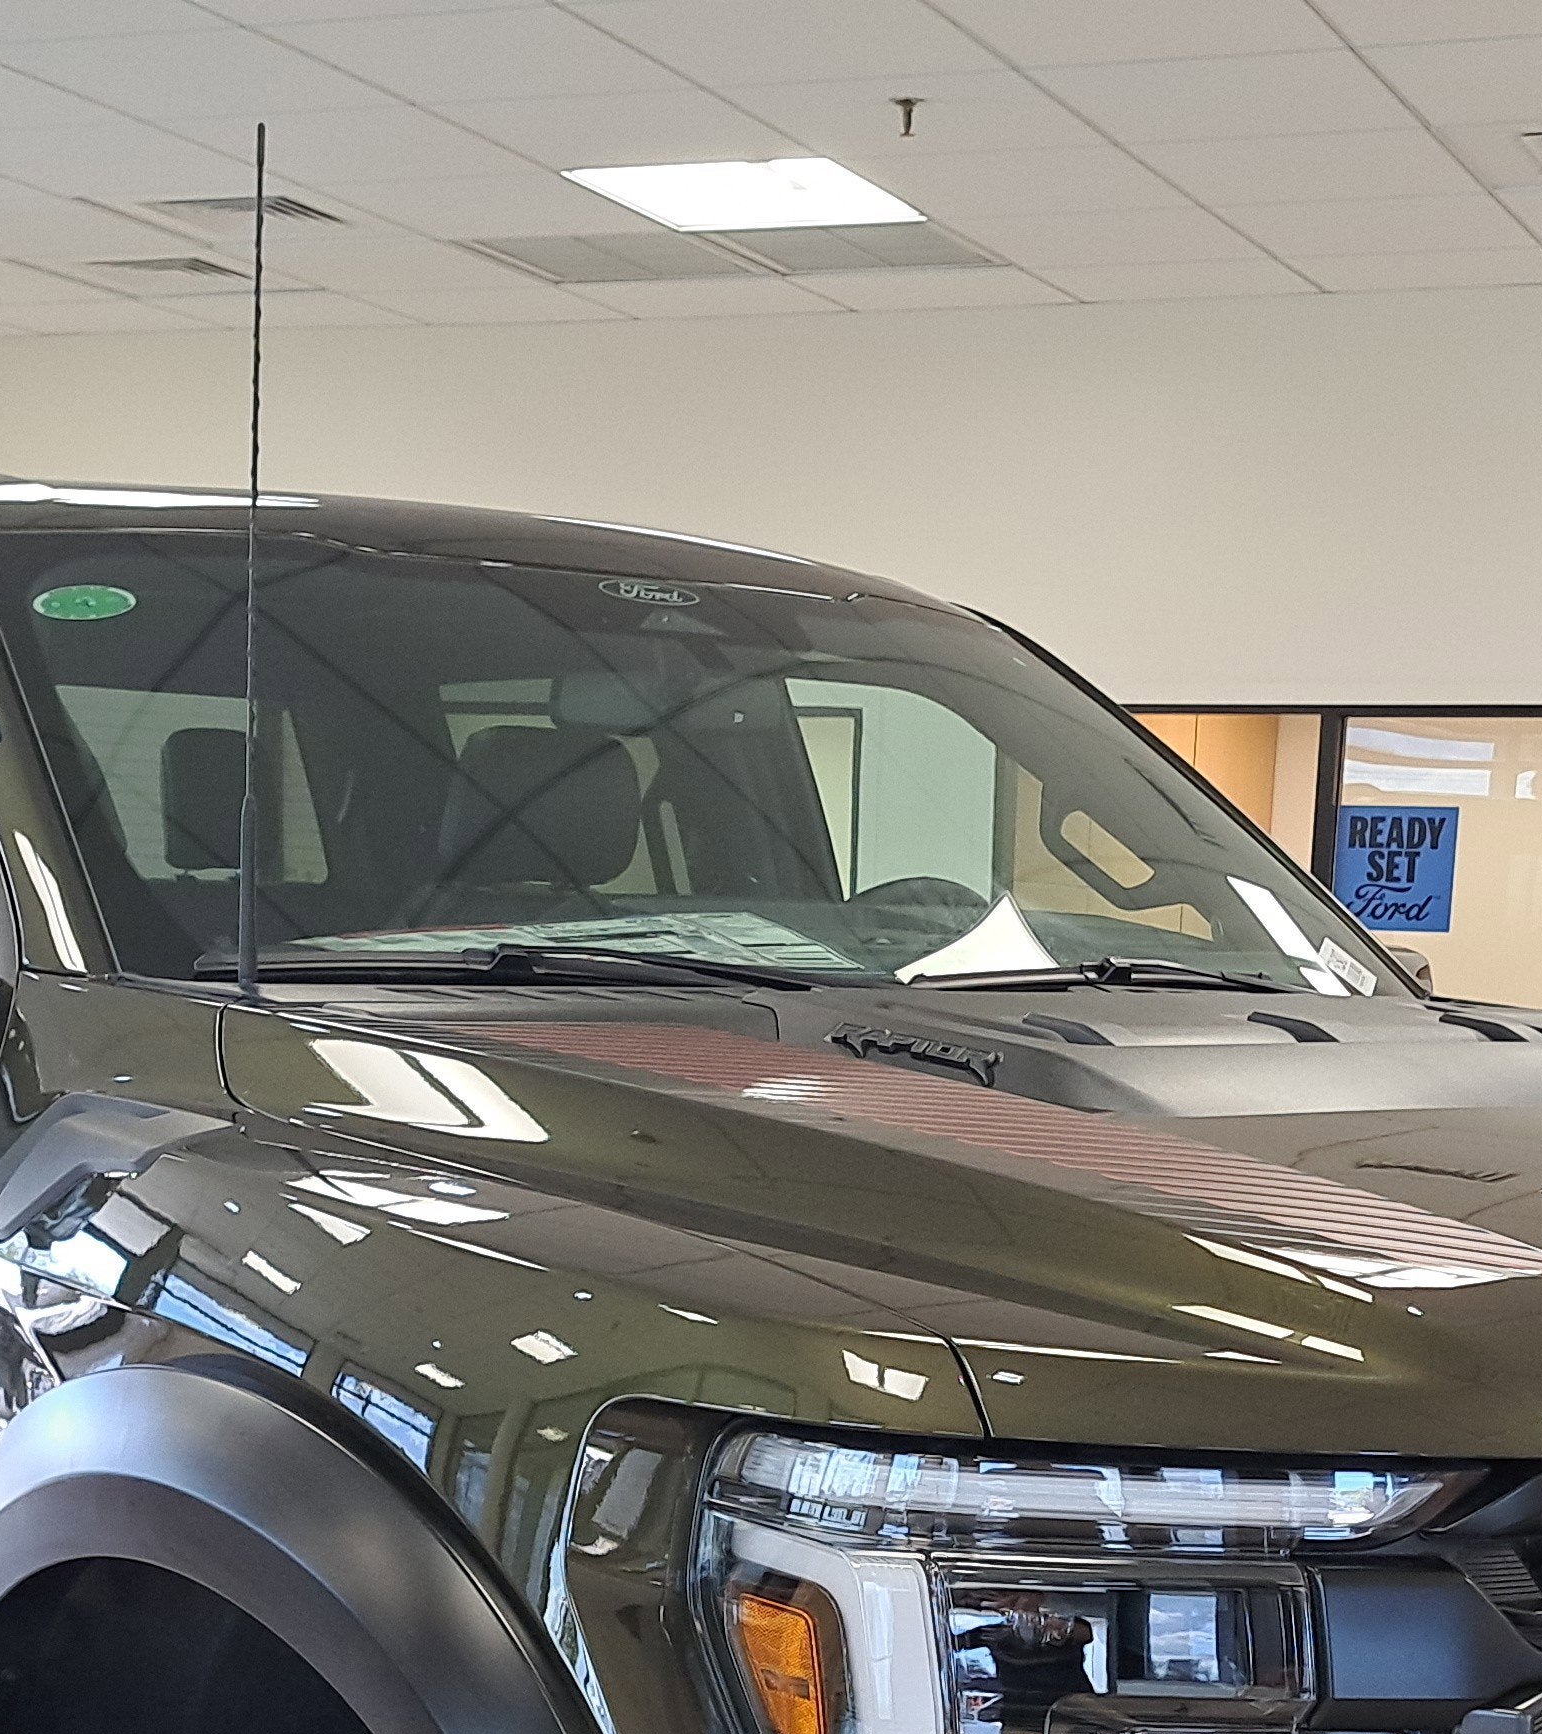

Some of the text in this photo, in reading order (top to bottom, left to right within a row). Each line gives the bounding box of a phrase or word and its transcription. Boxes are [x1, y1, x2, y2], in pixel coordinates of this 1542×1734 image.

[1348, 815, 1446, 849] READY
[1367, 850, 1420, 883] SET
[1347, 884, 1434, 921] Ford
[824, 1022, 1005, 1087] RAPTOR
